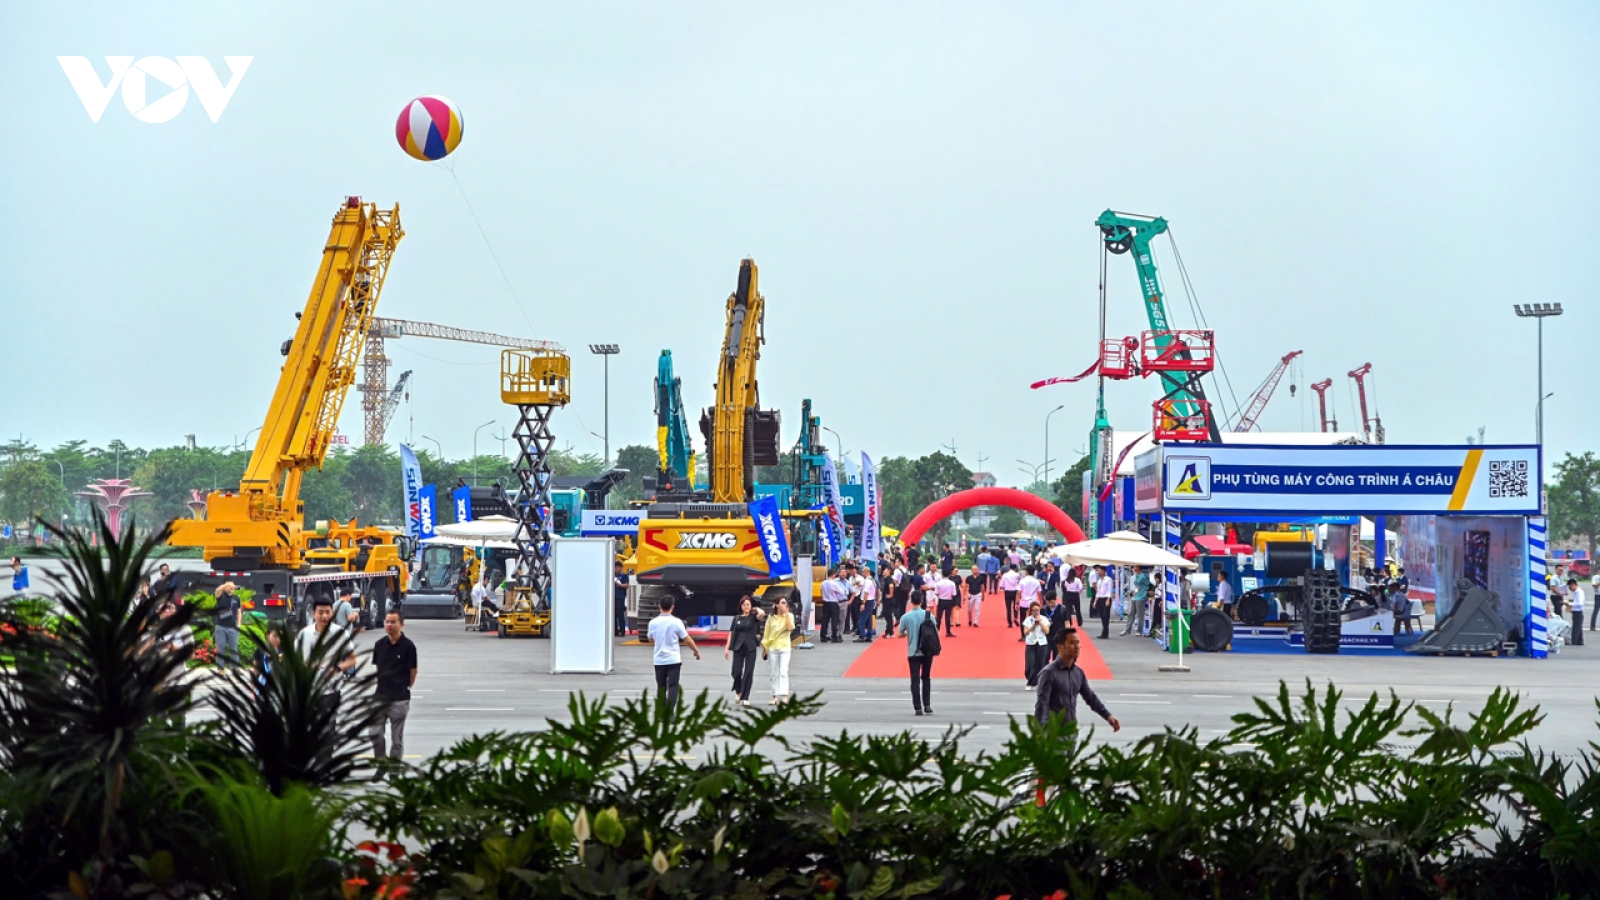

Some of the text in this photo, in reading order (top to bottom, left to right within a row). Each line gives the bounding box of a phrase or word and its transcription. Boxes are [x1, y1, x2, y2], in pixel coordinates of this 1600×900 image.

[1213, 471, 1453, 486] PHỤ TÙNG MÁY CÔNG TRÌNH Á CHÂU
[420, 496, 432, 534] XCMG
[457, 499, 466, 523] XCM
[606, 515, 639, 525] XCMG
[676, 532, 737, 549] XCMG
[757, 513, 782, 564] XCMG
